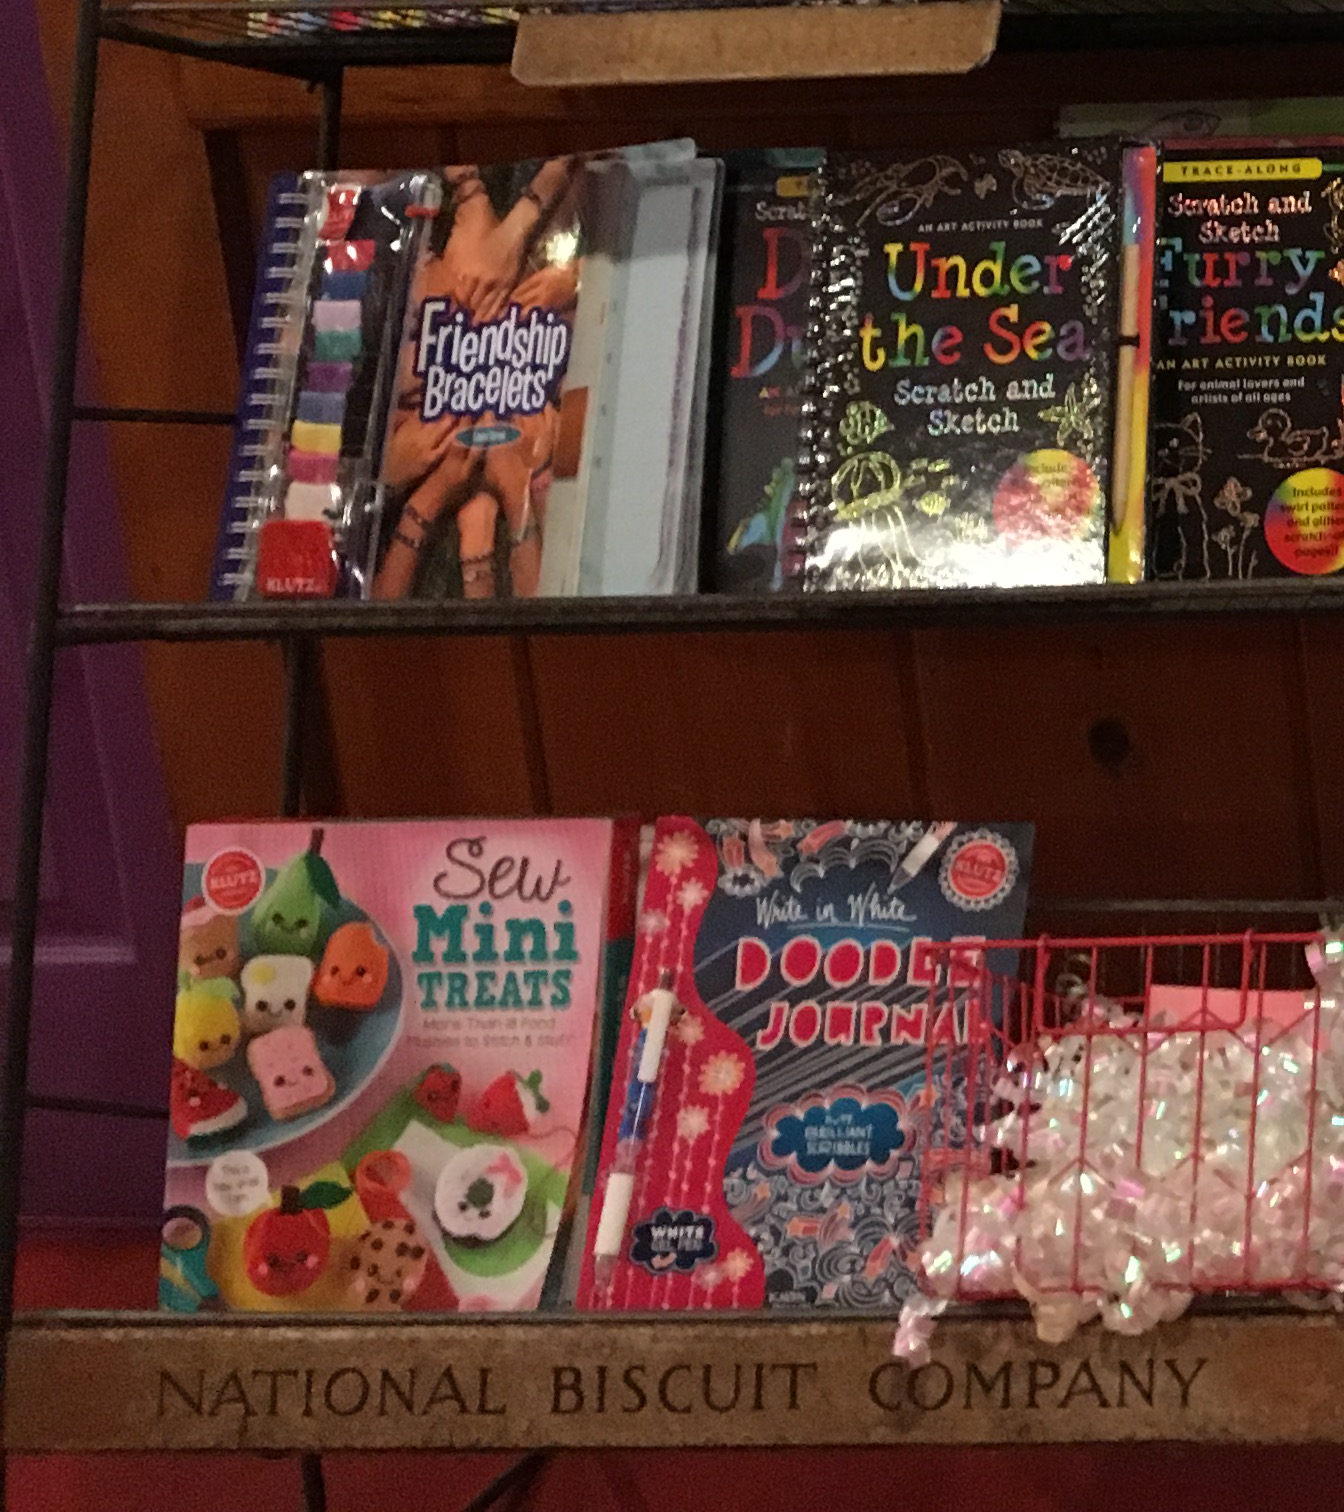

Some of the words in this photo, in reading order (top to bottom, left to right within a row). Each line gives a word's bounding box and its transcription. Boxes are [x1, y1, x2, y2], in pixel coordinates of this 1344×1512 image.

[1180, 162, 1303, 178] TRACE-ALONG
[1166, 191, 1260, 217] Scratch
[1267, 190, 1313, 215] and
[917, 223, 935, 233] AN
[936, 222, 960, 233] ART
[960, 220, 1012, 232] ACTIVITY
[1013, 218, 1044, 230] BOOK
[1198, 219, 1281, 245] Sketch
[882, 240, 1074, 302] Under
[416, 300, 568, 380] Friendship
[859, 311, 964, 373] the
[982, 302, 1094, 366] Sea
[1156, 357, 1176, 370] AN
[1181, 356, 1211, 370] ART
[1214, 355, 1281, 369] ACTIVITY
[1286, 353, 1328, 368] BOOK
[423, 365, 549, 420] Bracelets
[892, 375, 998, 406] Scratch
[1005, 373, 1057, 402] and
[1199, 378, 1241, 391] animal
[1243, 377, 1281, 390] lovers
[1282, 375, 1306, 388] and
[926, 406, 1022, 438] Sketch
[265, 576, 315, 594] KLUTZ
[433, 834, 572, 902] Sew
[755, 896, 806, 928] Write
[815, 899, 838, 925] in
[848, 893, 917, 924] White
[412, 899, 579, 964] Mini
[734, 935, 987, 992] DOODLE
[416, 968, 574, 1013] TREATS
[650, 1224, 705, 1240] WHITE
[155, 1362, 507, 1421] NATIONAL
[549, 1359, 818, 1418] BISCUIT
[867, 1353, 1208, 1415] COMPANY
